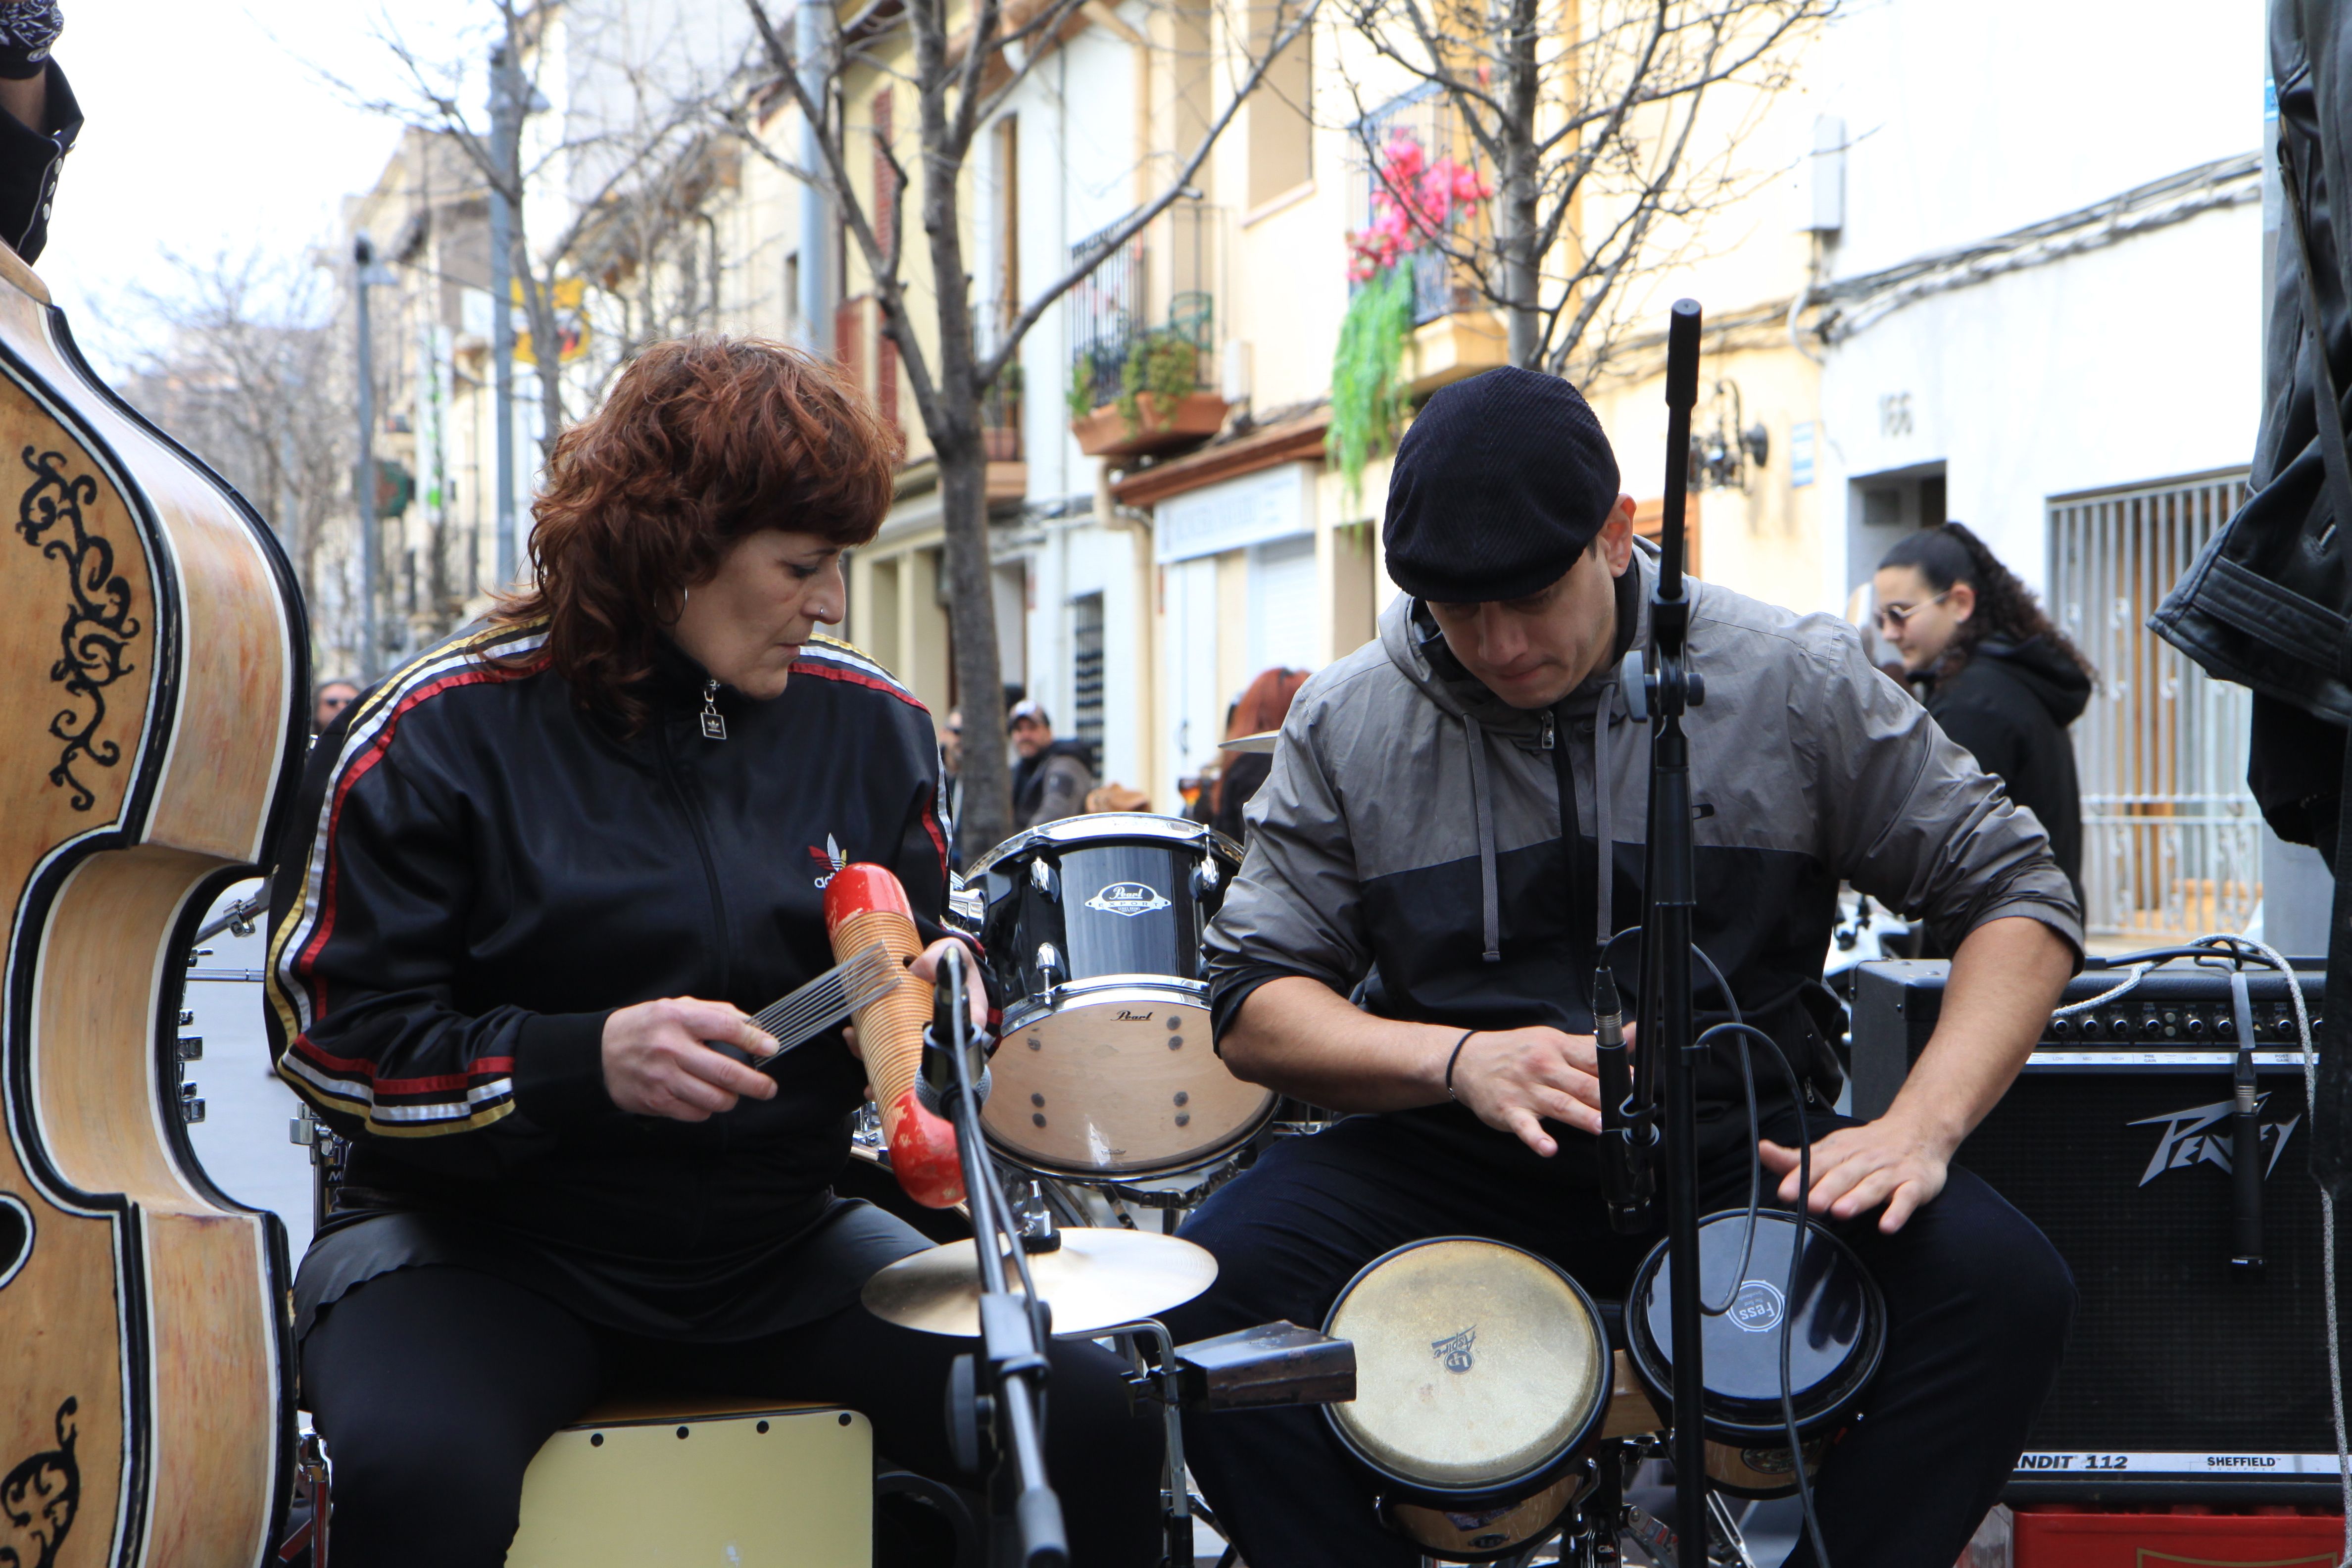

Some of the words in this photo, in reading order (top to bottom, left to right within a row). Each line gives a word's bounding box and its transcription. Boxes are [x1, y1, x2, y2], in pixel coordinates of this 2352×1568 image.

[1109, 886, 1143, 899] Pearl
[1110, 1010, 1153, 1021] Pearl
[1739, 1302, 1775, 1320] Fess
[1433, 1331, 1476, 1359] Aspire
[1448, 1353, 1470, 1368] LP
[2016, 1455, 2074, 1469] NDIT
[2084, 1455, 2128, 1469] 112
[2207, 1457, 2276, 1467] SHEFFIELD
